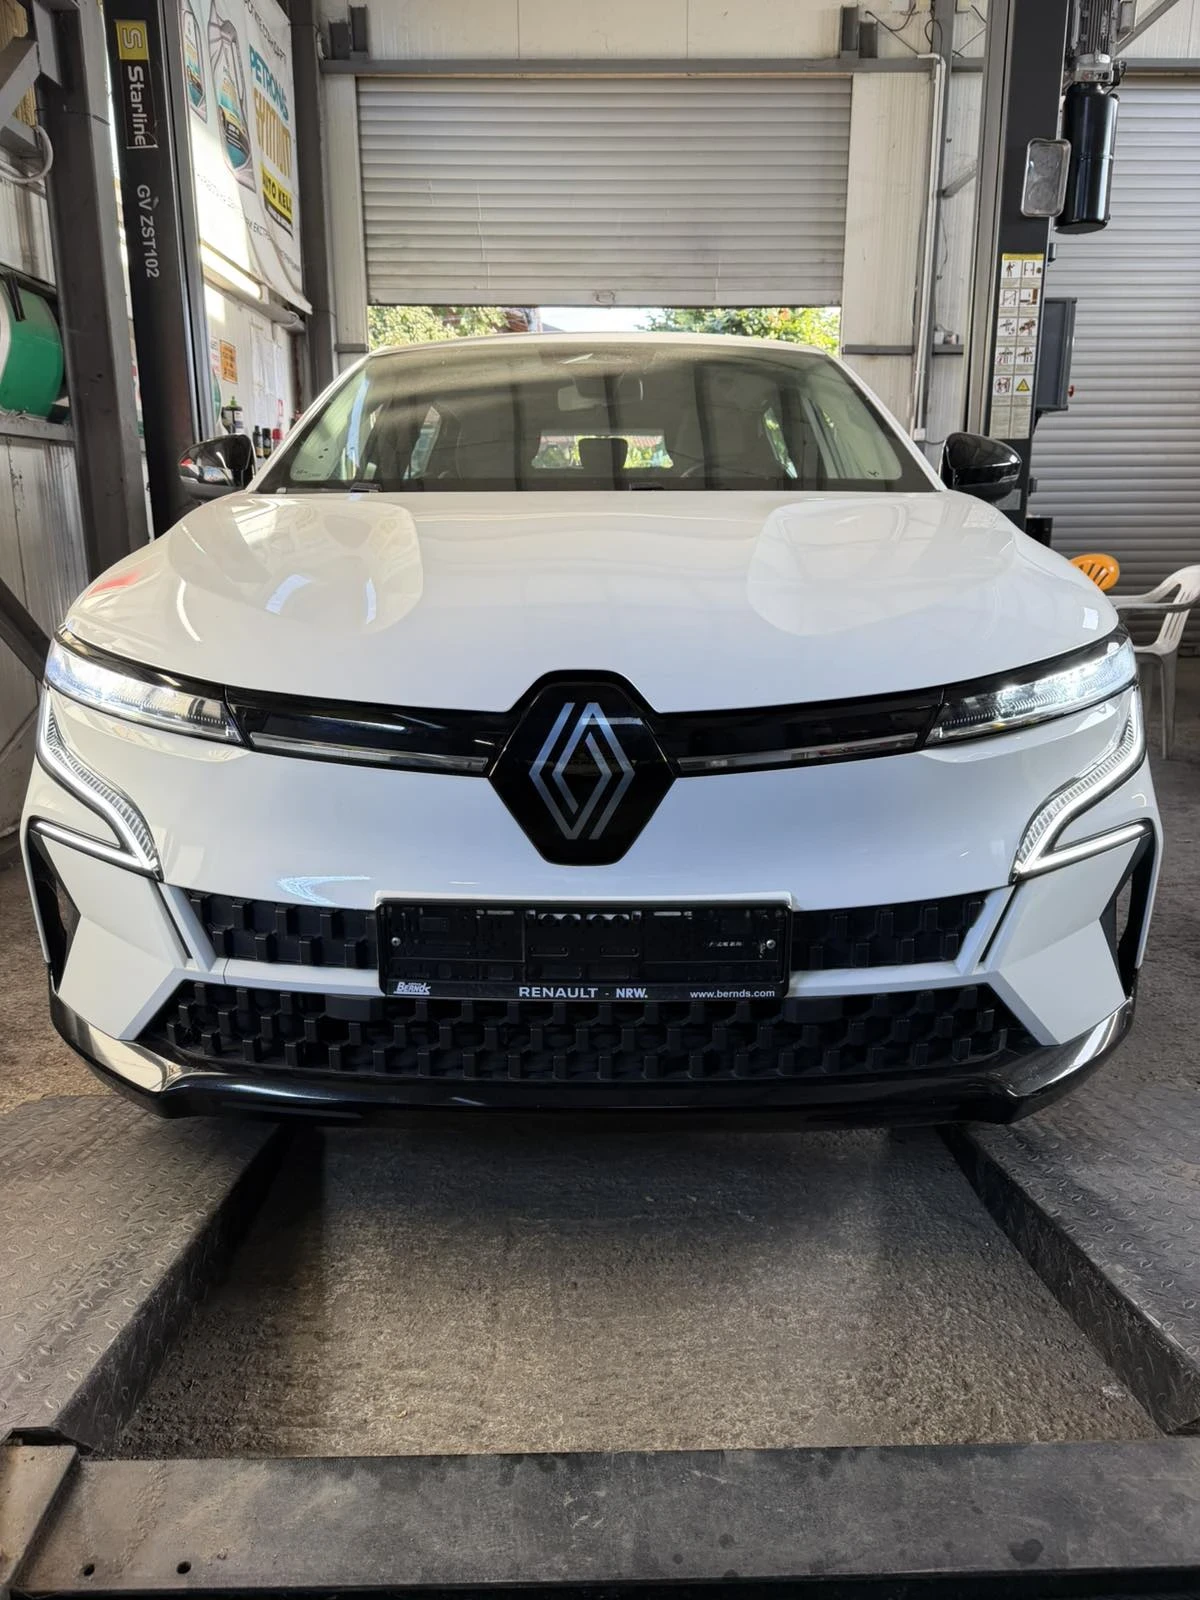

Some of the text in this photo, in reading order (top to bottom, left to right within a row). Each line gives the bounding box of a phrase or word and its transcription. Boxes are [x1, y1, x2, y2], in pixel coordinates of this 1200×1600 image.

[127, 65, 147, 146] Starline
[136, 184, 160, 278] GV ZST102
[519, 986, 599, 998] RENAULT
[615, 987, 648, 998] NRW.
[689, 988, 776, 998] www.bernds.com
